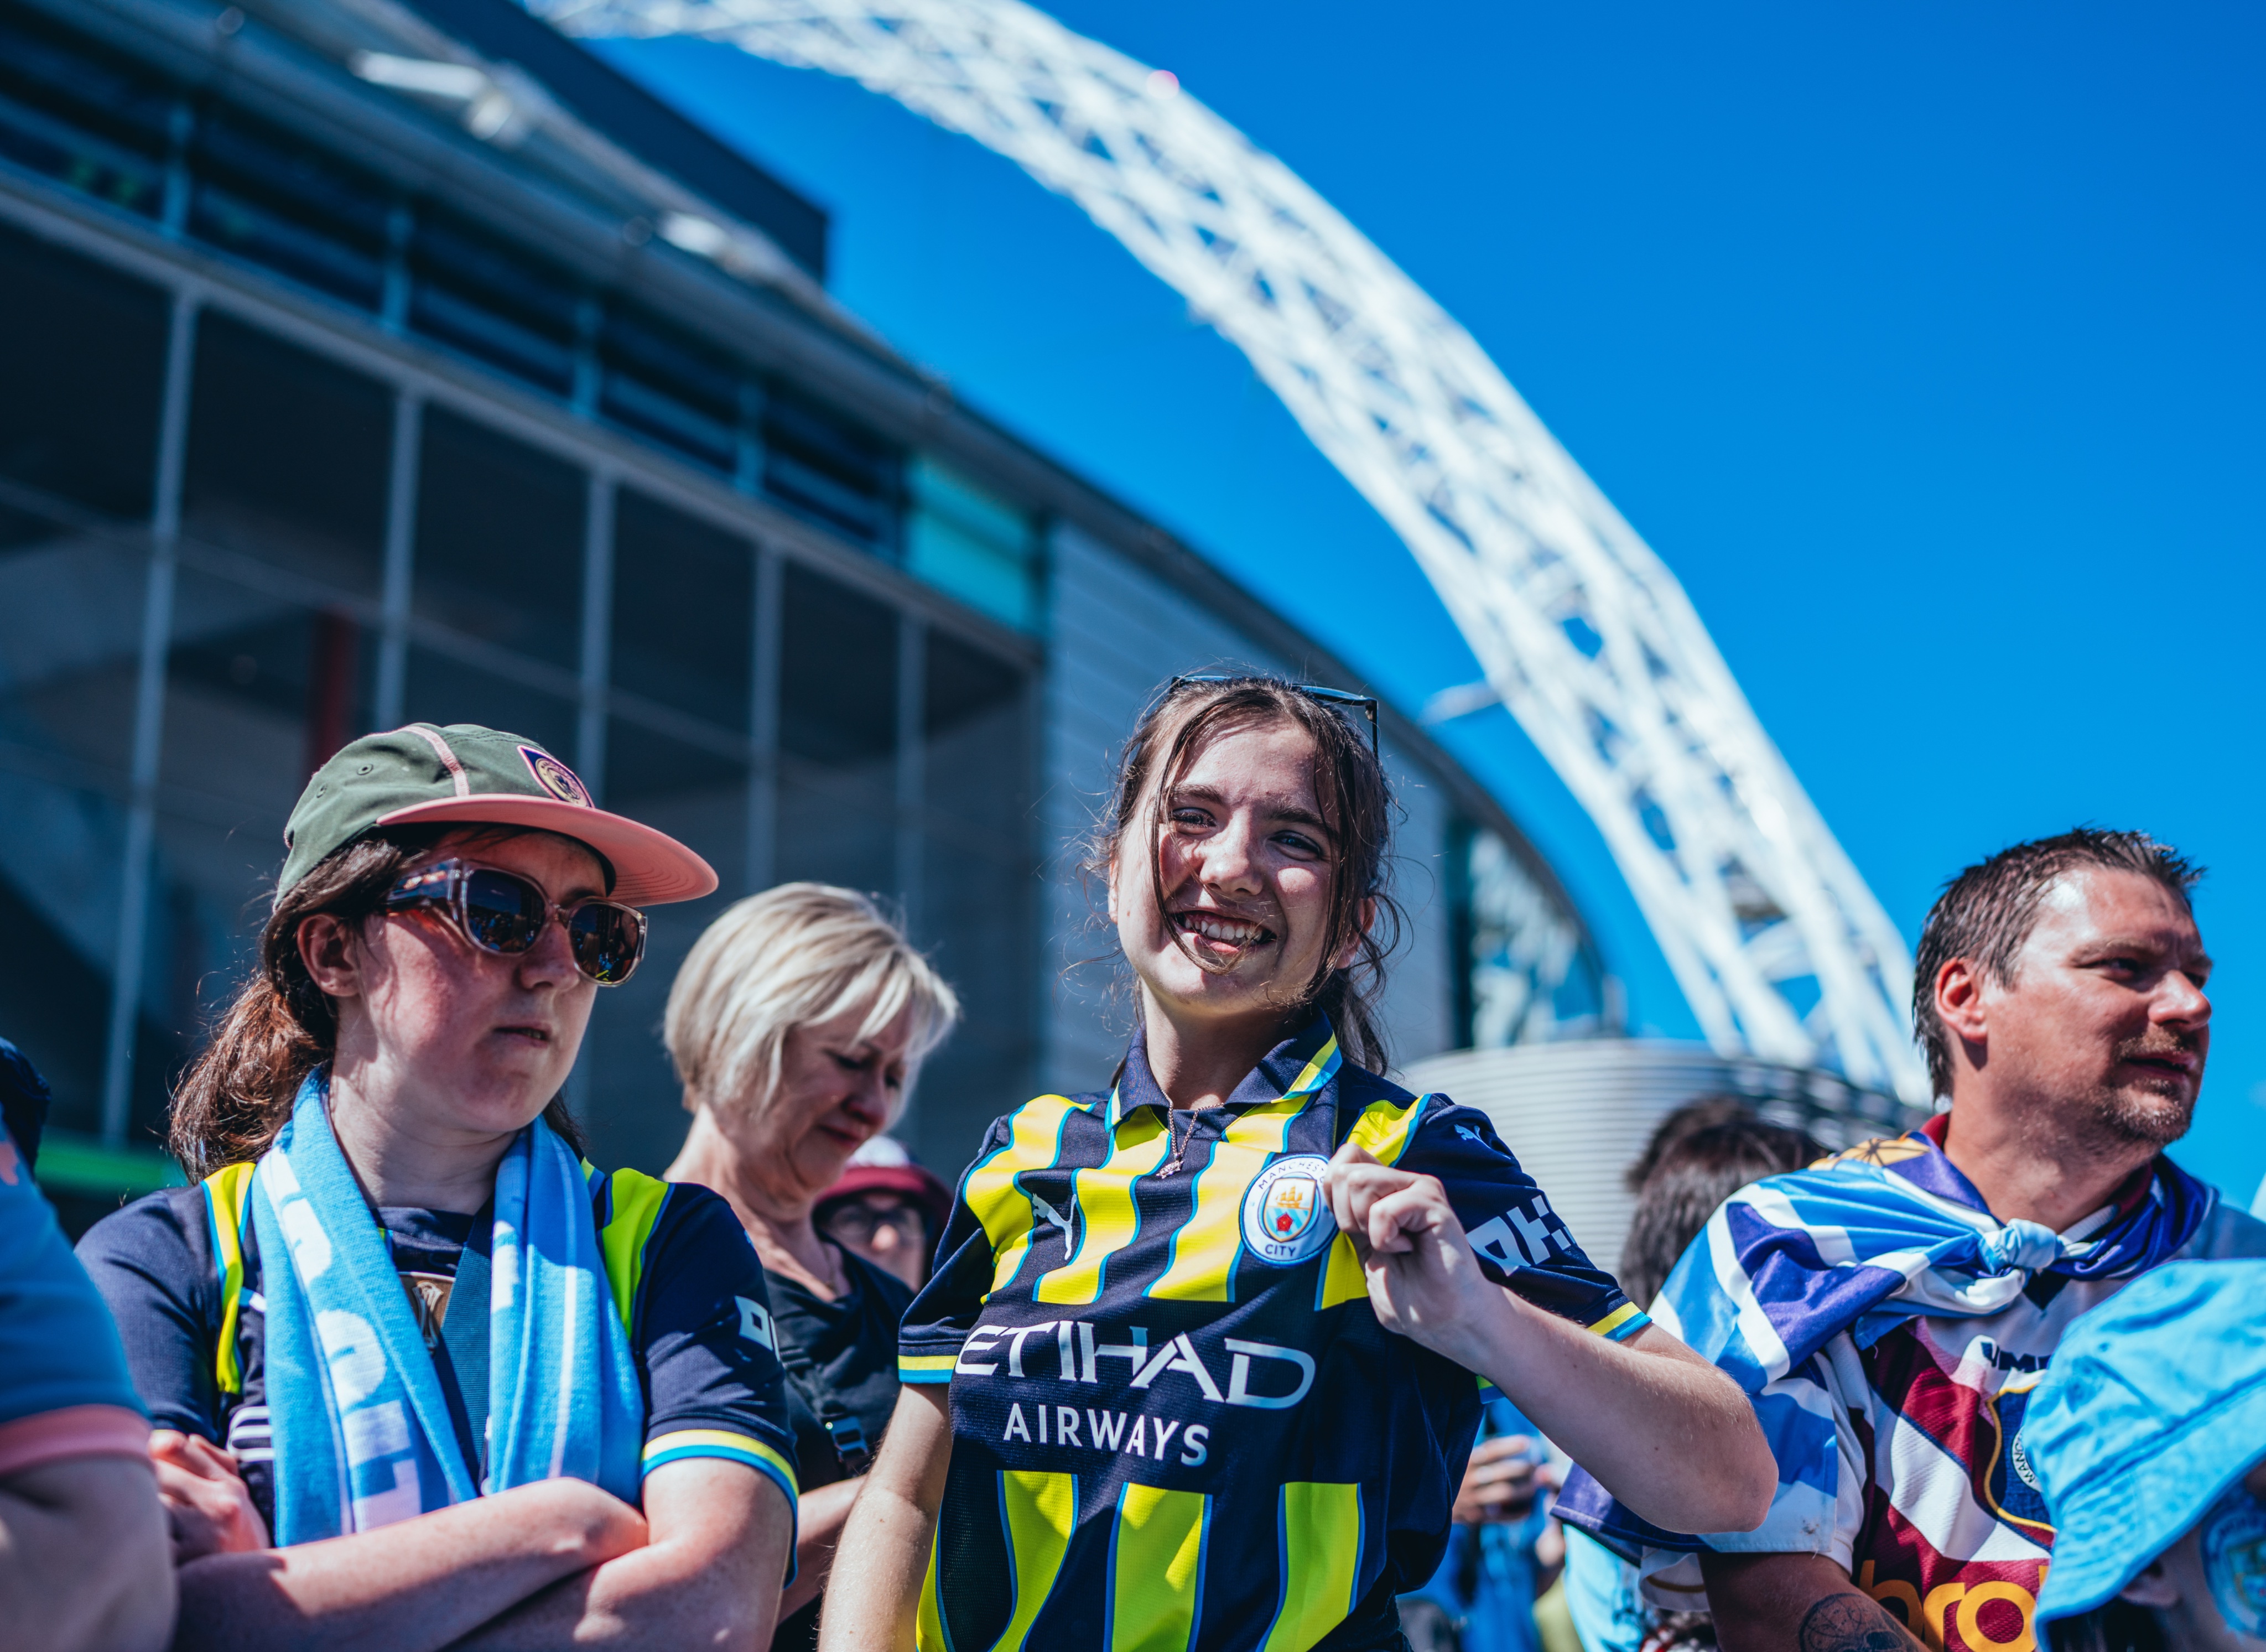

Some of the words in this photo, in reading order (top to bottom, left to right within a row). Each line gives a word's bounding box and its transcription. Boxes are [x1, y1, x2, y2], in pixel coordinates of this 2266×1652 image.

[1265, 1244, 1296, 1256] CITY
[1465, 1192, 1577, 1277] OK
[955, 1319, 1316, 1410] ETIHAD
[1003, 1402, 1209, 1467] AIRWAYS
